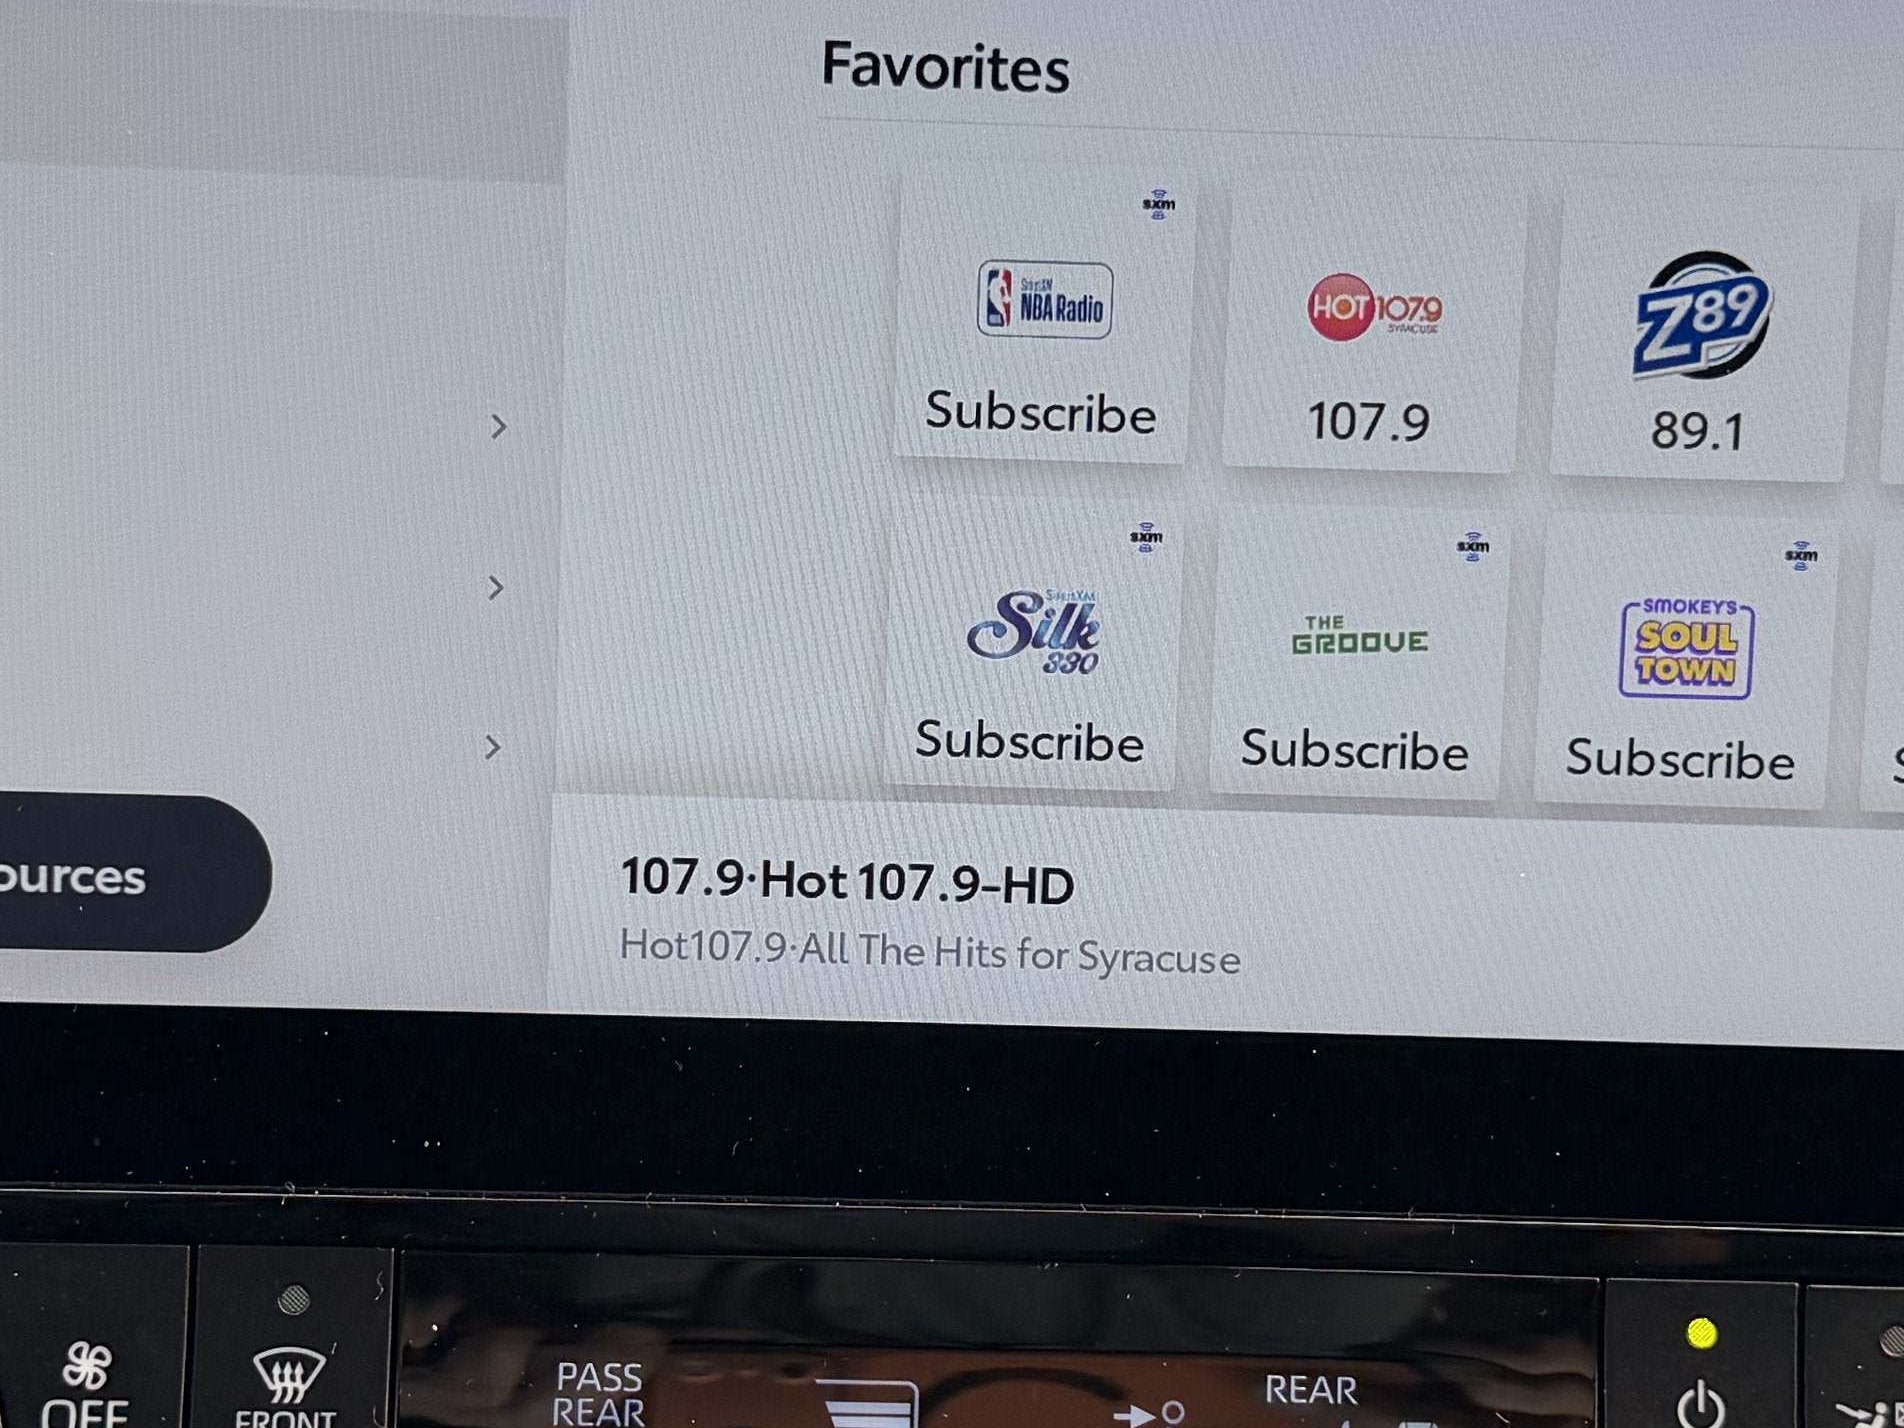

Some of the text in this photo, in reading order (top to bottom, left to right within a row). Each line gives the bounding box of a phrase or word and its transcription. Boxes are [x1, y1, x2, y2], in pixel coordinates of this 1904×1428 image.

[822, 39, 1071, 94] Favorites
[1142, 199, 1176, 211] sxm
[1020, 293, 1104, 323] NBA Radio
[1313, 294, 1370, 320] HOT
[1643, 283, 1759, 362] Z89
[925, 389, 1156, 435] Subscribe
[1309, 400, 1431, 442] 107.9
[1651, 410, 1745, 453] 89.1
[1456, 541, 1490, 553] sxm
[1785, 549, 1818, 563] sxm
[967, 590, 1100, 659] Silk
[1305, 615, 1345, 630] THE
[1636, 620, 1739, 654] SOUL
[1292, 631, 1428, 654] GROOVE
[1636, 655, 1736, 685] TOWN
[915, 719, 1144, 764] Subscribe
[1241, 728, 1469, 773] Subscribe
[1566, 738, 1796, 784] Subscribe
[859, 934, 925, 966] The
[935, 936, 1008, 969] Hits
[1017, 937, 1070, 970] for
[1078, 939, 1242, 980] Syracuse
[557, 1362, 643, 1393] PASS
[1266, 1375, 1358, 1406] REAR
[552, 1398, 645, 1428] REAR
